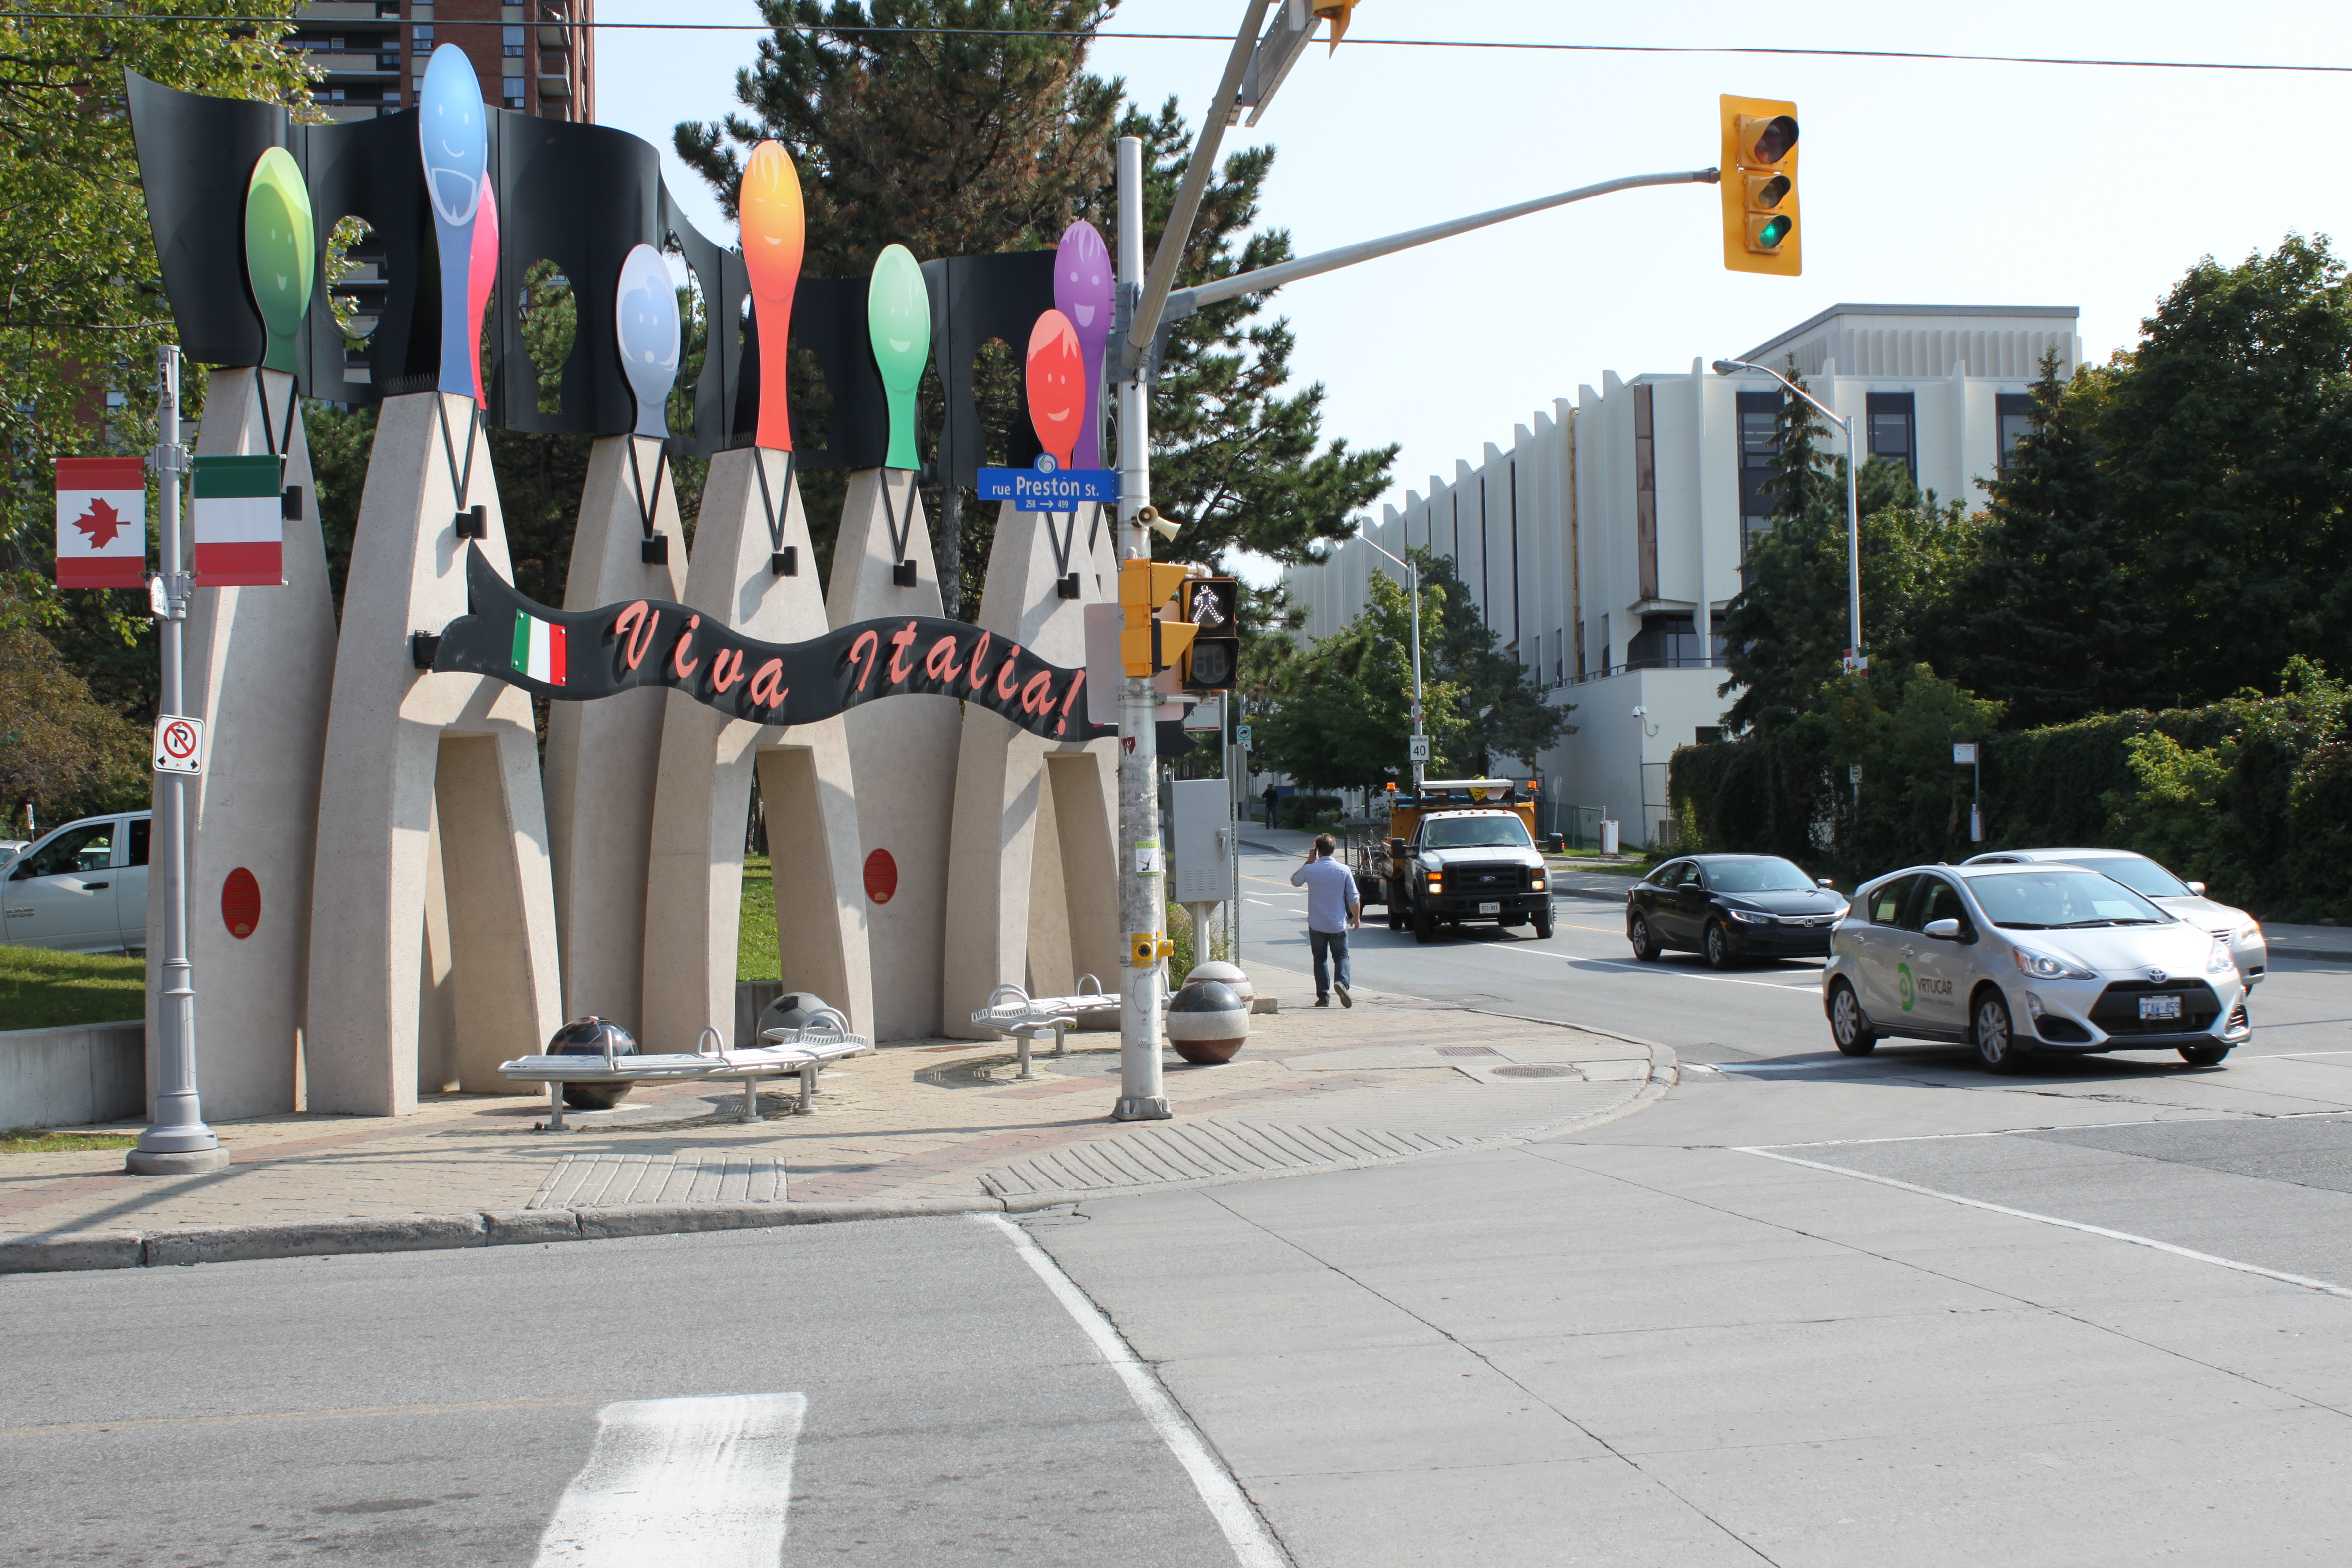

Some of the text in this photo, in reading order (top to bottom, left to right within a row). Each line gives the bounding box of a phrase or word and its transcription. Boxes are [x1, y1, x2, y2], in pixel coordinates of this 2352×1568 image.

[992, 476, 1099, 496] rue Preston St.
[1026, 499, 1069, 509] 258 499
[615, 599, 1086, 735] Viva Italia!
[1413, 745, 1426, 756] 40
[1916, 977, 1953, 996] VRTUCAR
